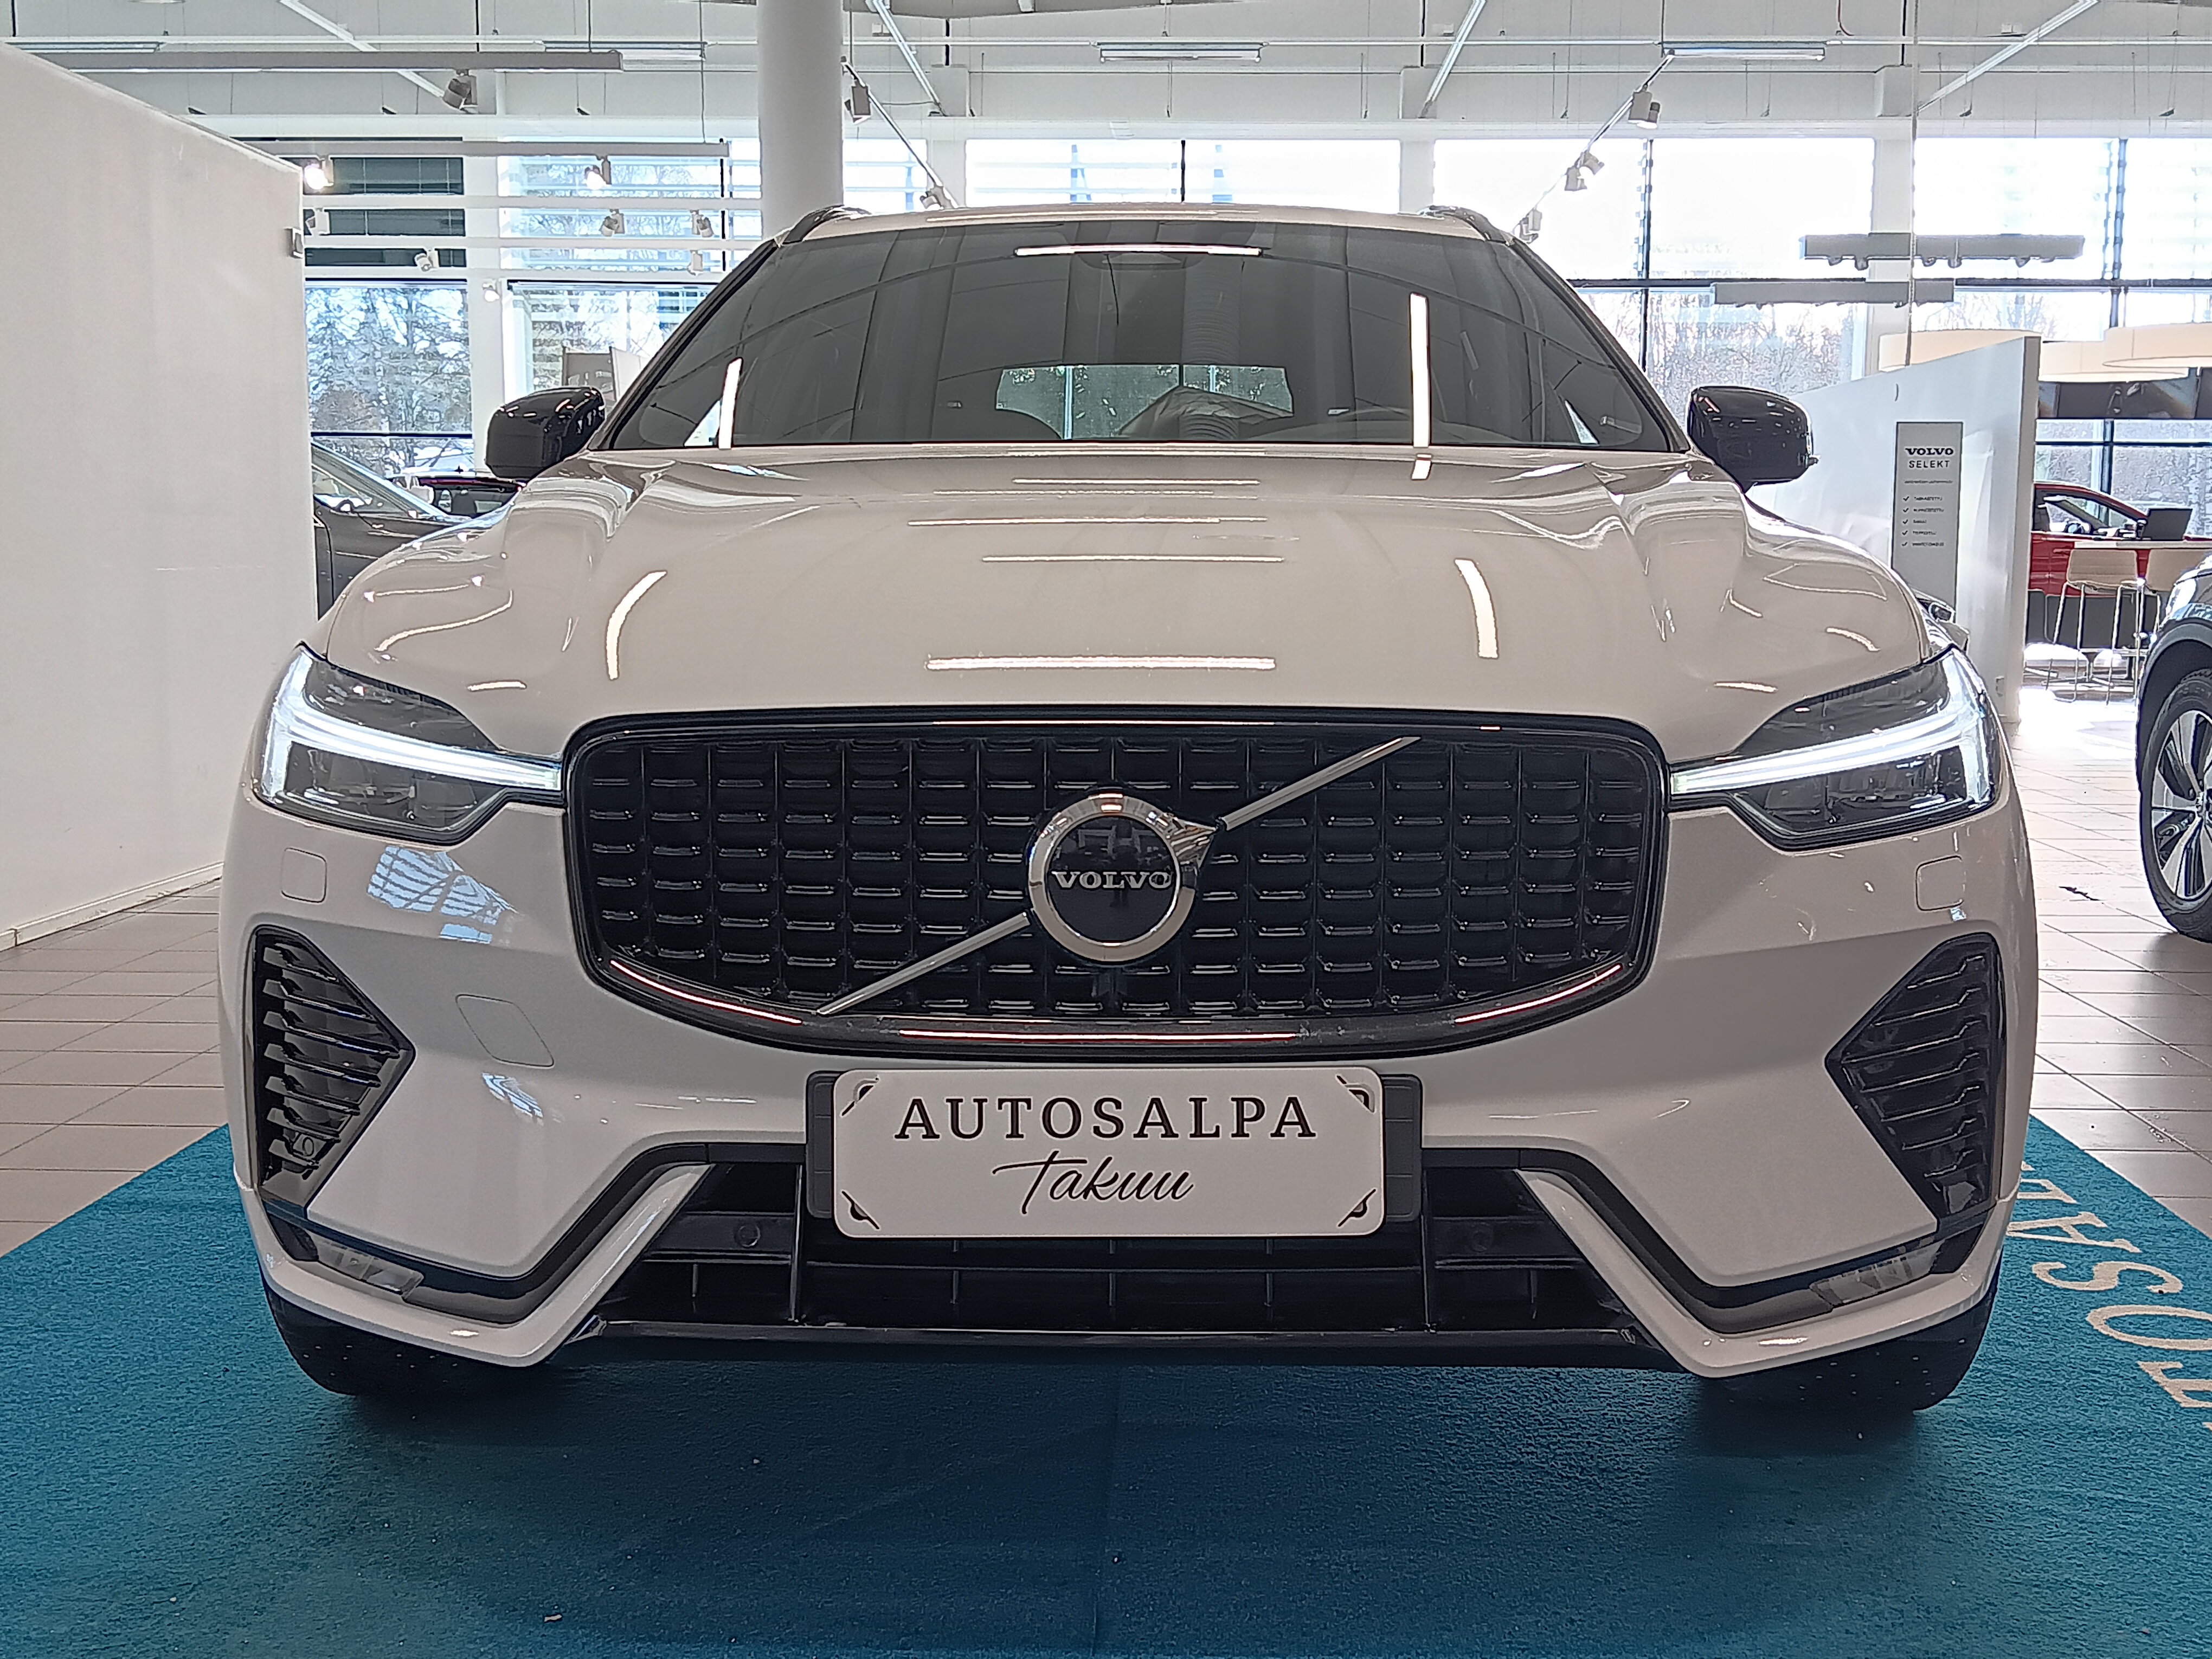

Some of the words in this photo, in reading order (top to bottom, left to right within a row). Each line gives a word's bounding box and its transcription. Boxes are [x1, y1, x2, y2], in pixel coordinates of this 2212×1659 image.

[1051, 871, 1173, 889] VOLVO
[894, 1096, 1316, 1139] AUTOSALPA
[992, 1150, 1194, 1214] Takuu
